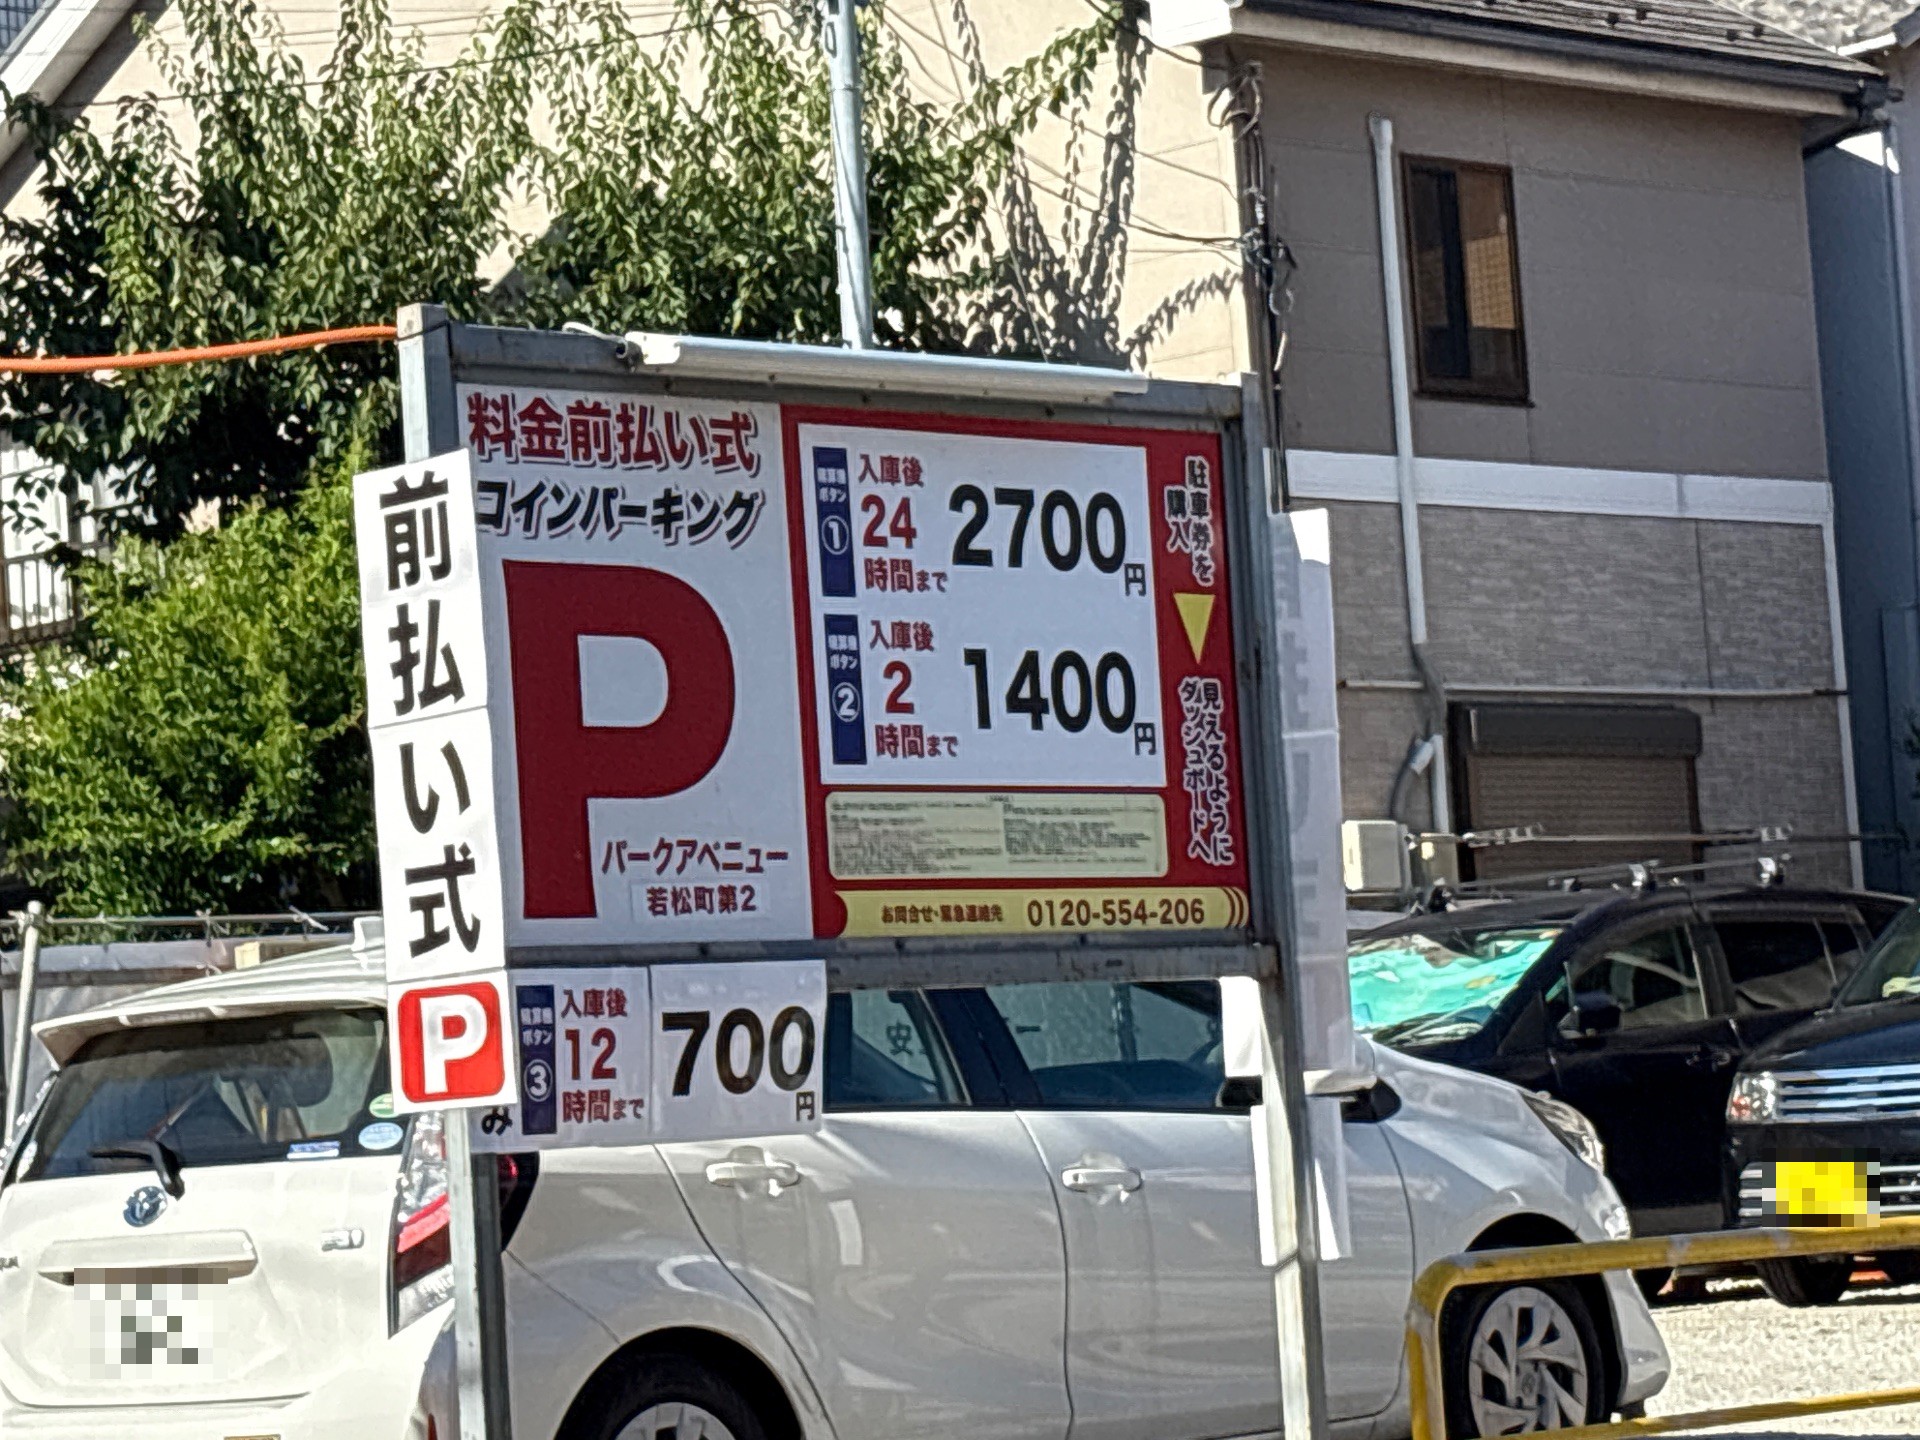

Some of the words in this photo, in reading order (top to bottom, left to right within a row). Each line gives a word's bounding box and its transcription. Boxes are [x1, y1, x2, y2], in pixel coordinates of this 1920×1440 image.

[467, 391, 762, 478] 料金前払い式
[859, 455, 924, 487] 入庫後
[477, 480, 764, 548] コインパーキング
[861, 494, 917, 549] 24
[948, 484, 1126, 573] 2700
[1124, 563, 1147, 597] 円
[865, 557, 948, 593] 時間まで
[870, 620, 934, 651] 入庫後
[379, 471, 481, 958] 前払い式
[883, 661, 915, 714] 2
[964, 647, 1136, 733] 1400
[1134, 722, 1157, 756] 円
[502, 559, 735, 919] P
[875, 725, 958, 758] 時間まで
[1181, 680, 1210, 859] ダッシュボードへ
[1202, 682, 1232, 862] 見えるように
[601, 837, 789, 876] パークアベニュー
[646, 884, 757, 916] 若松町第2
[1027, 898, 1206, 927] 0120-554-206
[561, 989, 628, 1018] 入庫後
[419, 994, 488, 1096] P
[565, 1028, 617, 1080] 12
[661, 1006, 816, 1096] 700
[795, 1091, 816, 1122] 円
[562, 1090, 644, 1123] 時間まで
